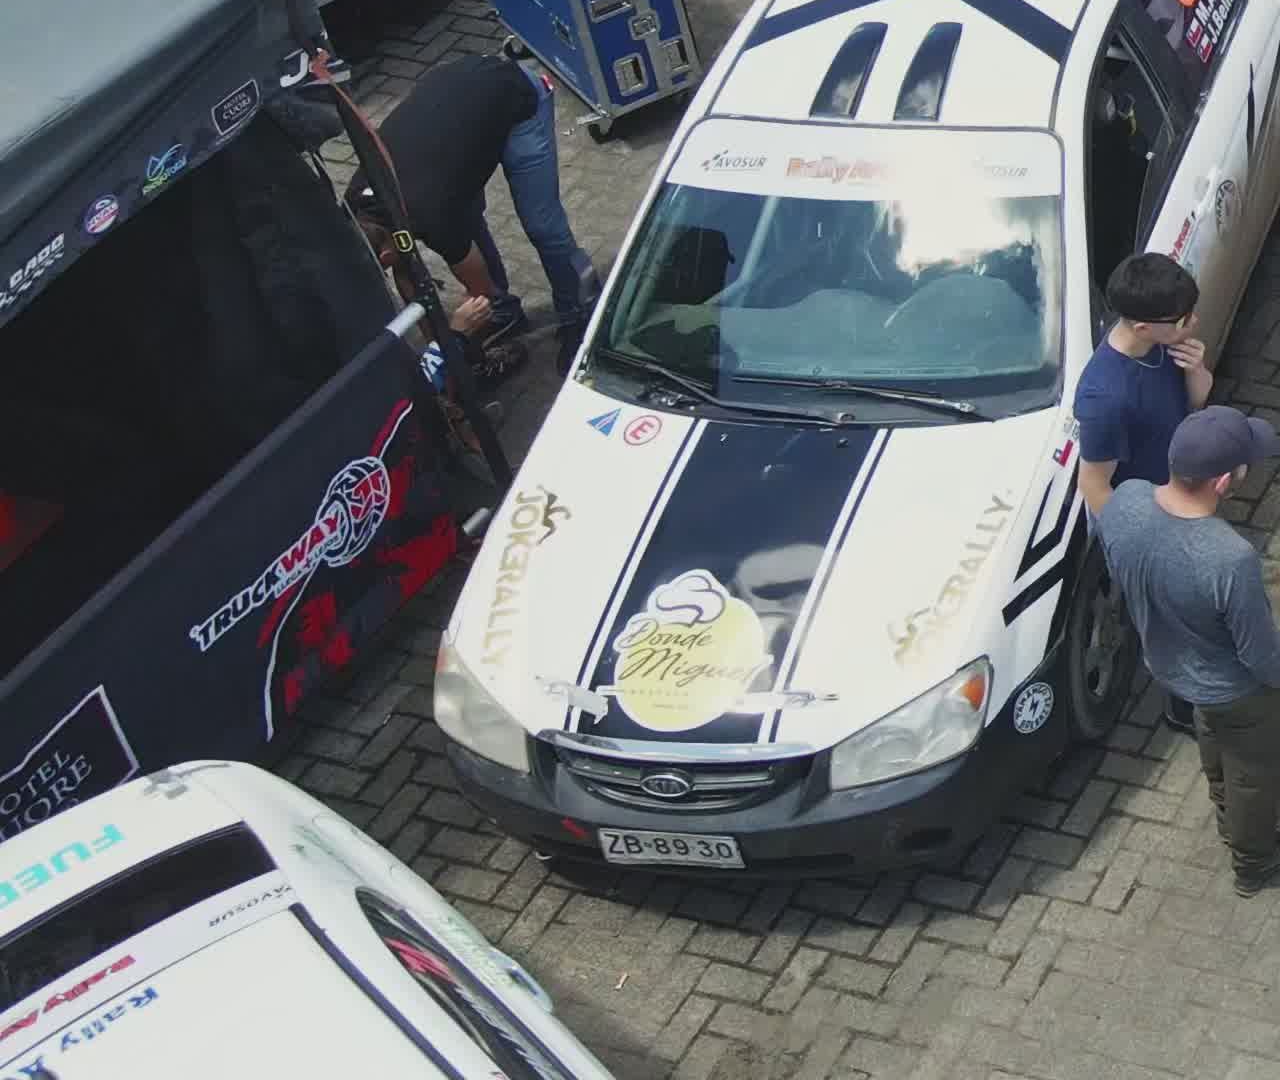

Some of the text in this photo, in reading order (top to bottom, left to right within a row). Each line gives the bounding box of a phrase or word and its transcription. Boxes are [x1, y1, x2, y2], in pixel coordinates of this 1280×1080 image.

[714, 155, 768, 170] AVOSUR
[198, 512, 340, 652] TRUCKWAY
[618, 618, 713, 651] Donde
[696, 840, 734, 859] 30
[60, 986, 160, 1052] Rally
